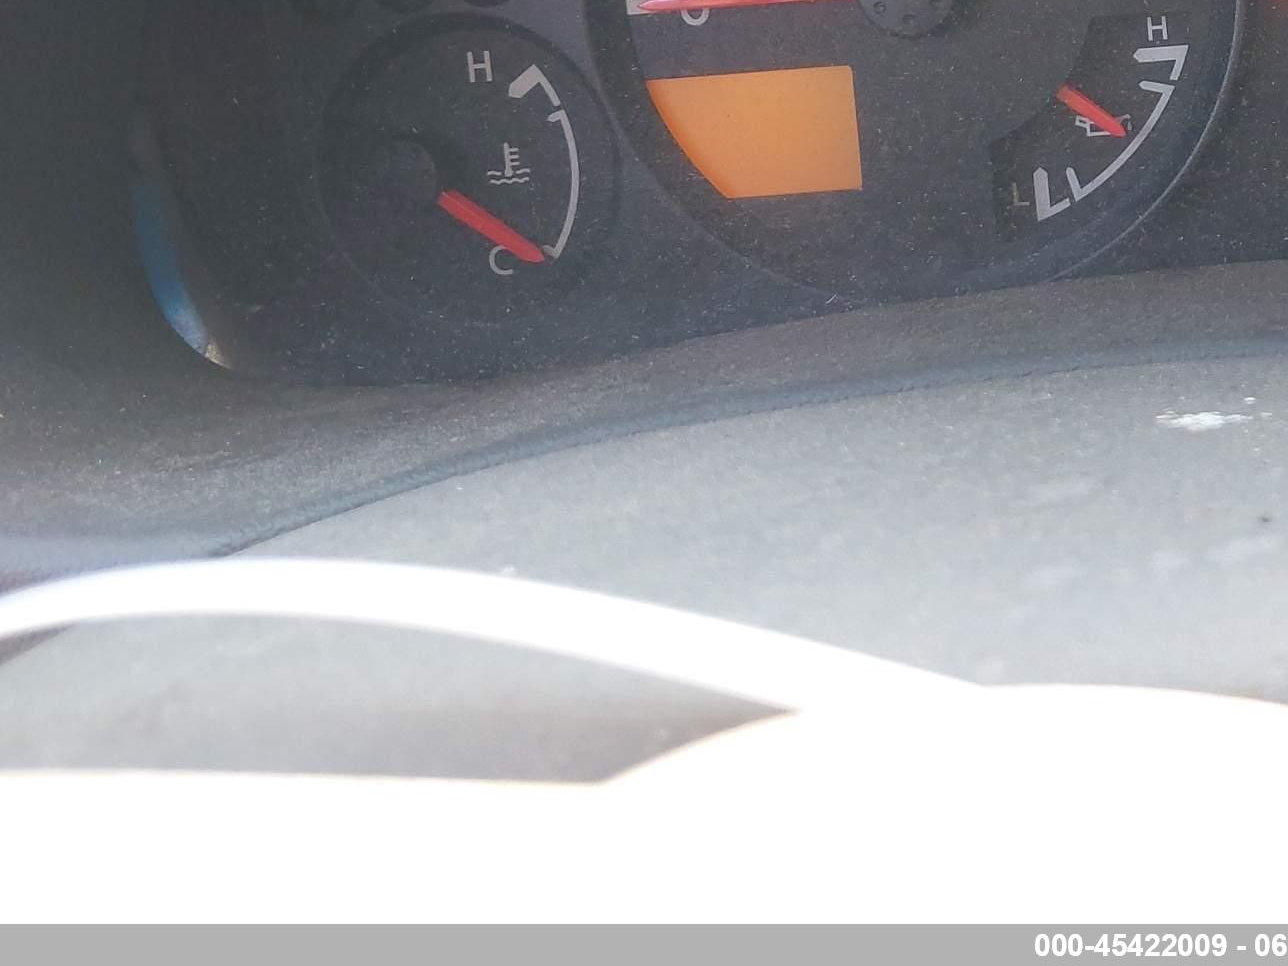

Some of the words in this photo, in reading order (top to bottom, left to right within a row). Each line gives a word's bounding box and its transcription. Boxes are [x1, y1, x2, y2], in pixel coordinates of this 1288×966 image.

[1147, 15, 1168, 41] H
[467, 50, 494, 83] H
[489, 244, 514, 276] C
